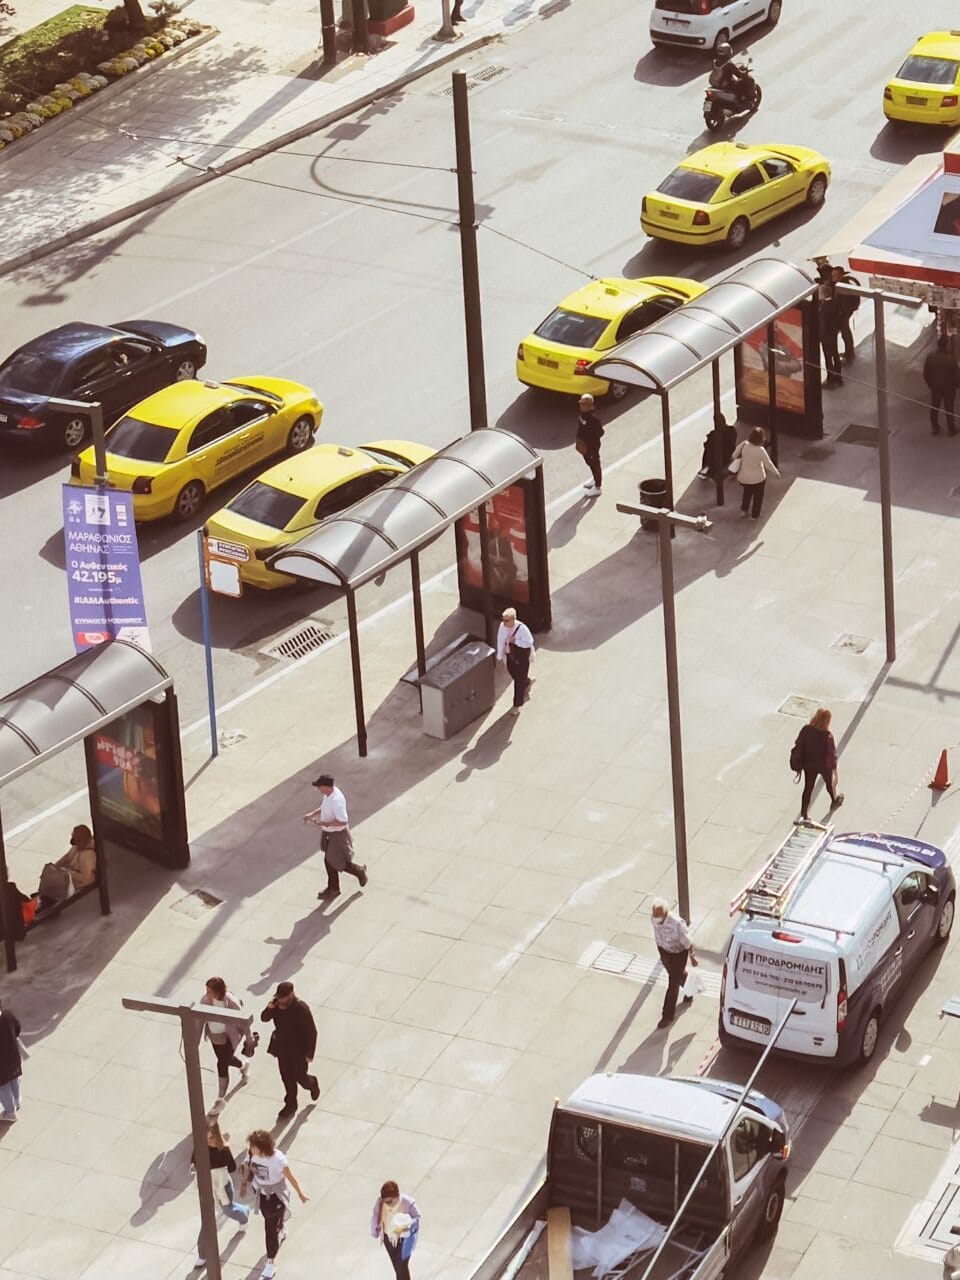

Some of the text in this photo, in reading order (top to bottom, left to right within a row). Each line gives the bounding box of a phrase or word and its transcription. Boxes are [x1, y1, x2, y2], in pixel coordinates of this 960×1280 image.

[68, 531, 132, 544] ΜΑΡΑΘΩΝΙΟΣ
[69, 543, 109, 554] ΑΘΗΝΑΣ
[756, 954, 824, 975] ΠΡΟΔΡΟΜΙΔΗΣ
